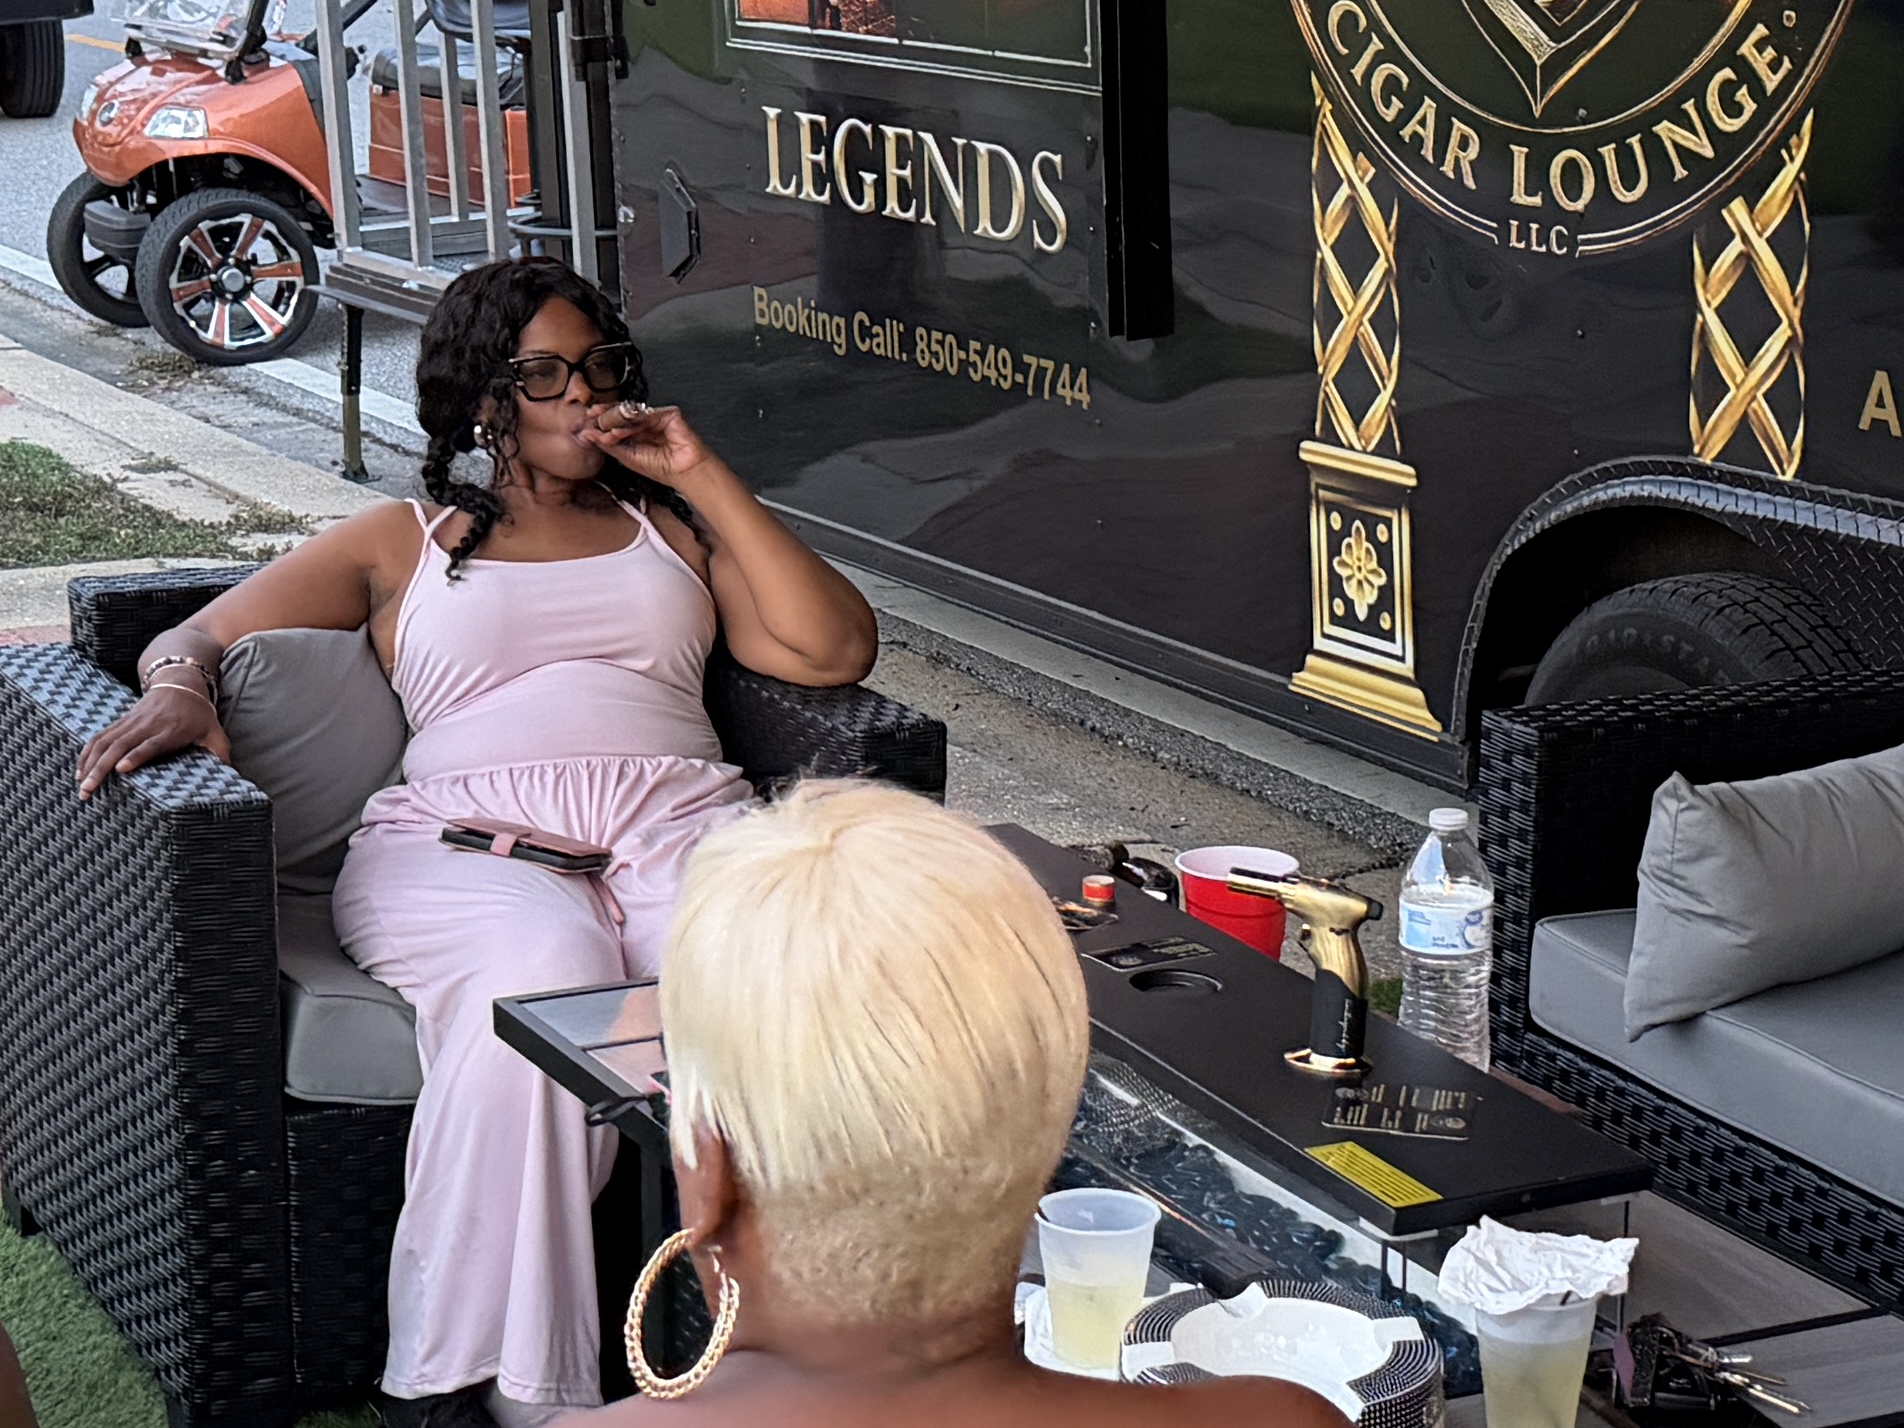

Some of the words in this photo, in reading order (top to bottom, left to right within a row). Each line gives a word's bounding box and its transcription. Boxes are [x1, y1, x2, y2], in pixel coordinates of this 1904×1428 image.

[1326, 0, 1480, 190] CIGAR
[1509, 23, 1794, 214] LOUNGE
[761, 105, 1069, 254] LEGENDS
[1508, 219, 1570, 257] LLC
[752, 285, 847, 347] Booking
[914, 325, 1091, 410] 850-549-7744
[1857, 369, 1902, 438] A
